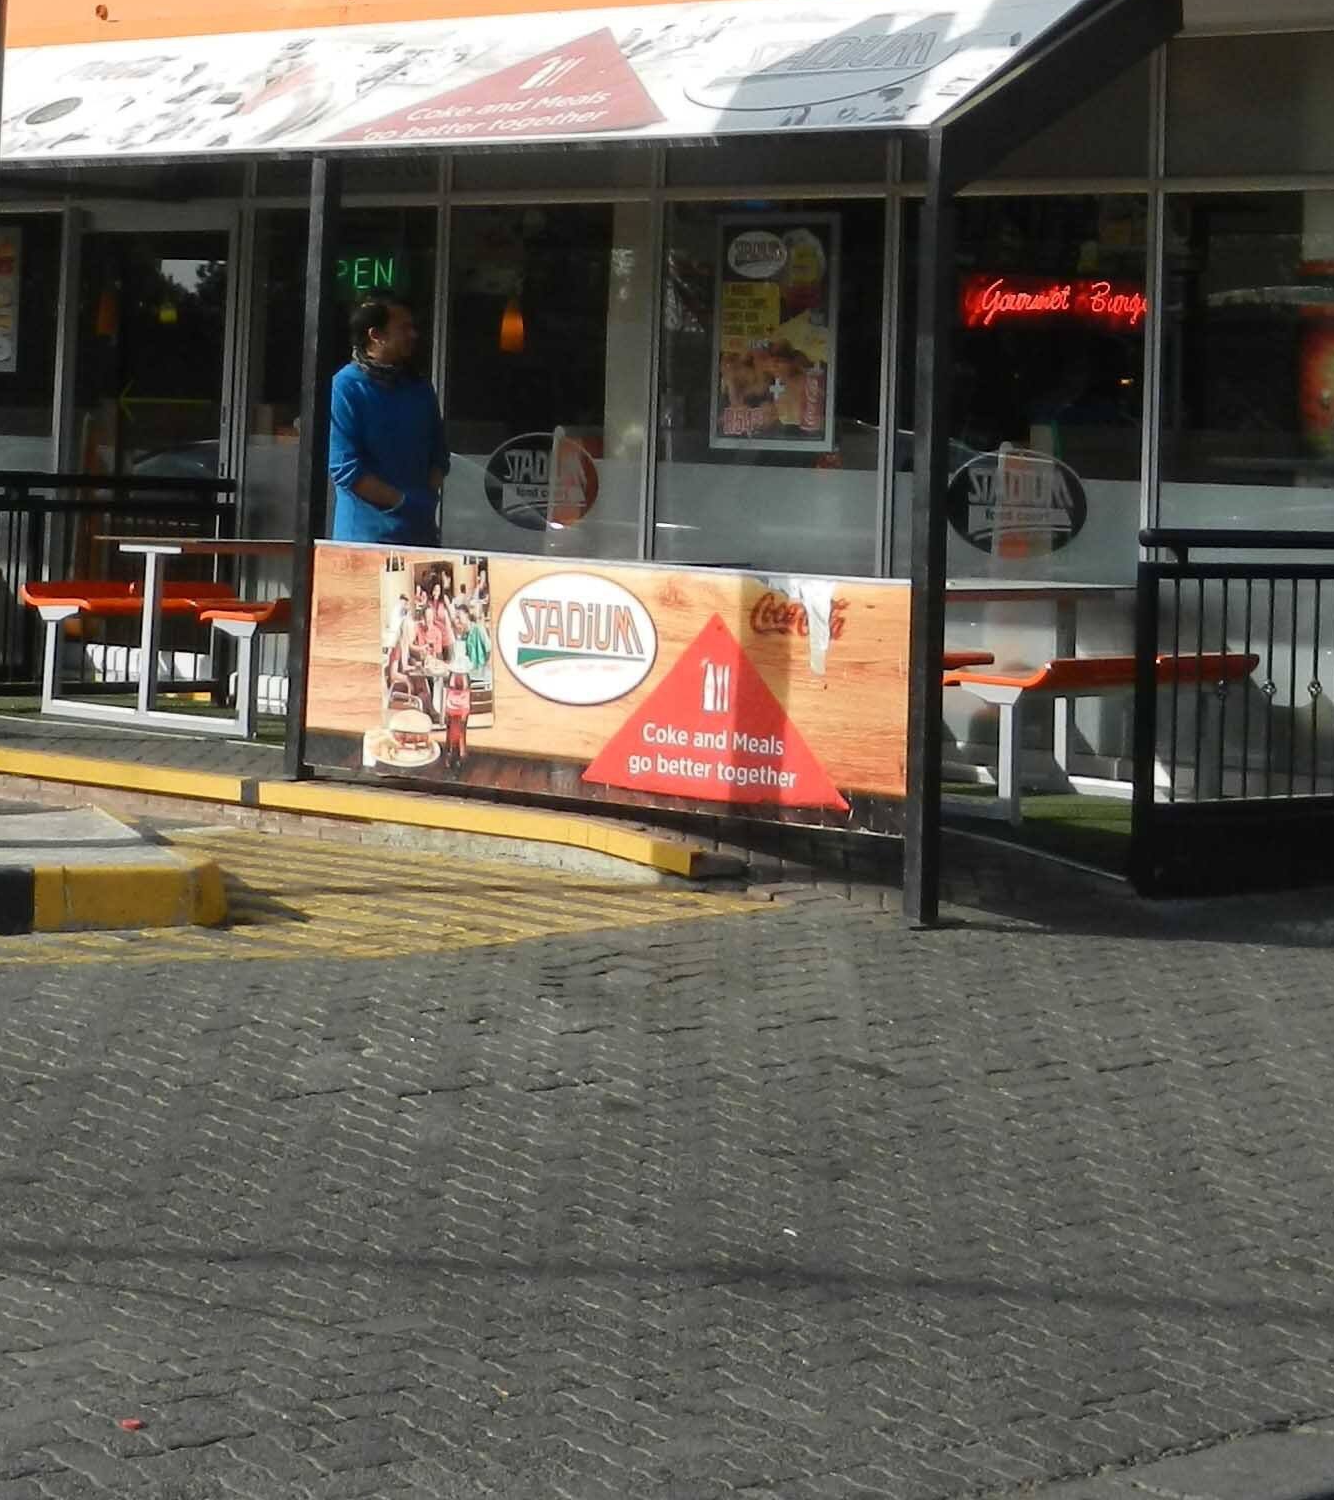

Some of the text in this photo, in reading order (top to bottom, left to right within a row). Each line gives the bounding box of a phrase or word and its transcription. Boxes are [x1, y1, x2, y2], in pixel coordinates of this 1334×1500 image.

[406, 89, 612, 123] Coke and Meals
[397, 120, 486, 140] better
[488, 108, 609, 134] together
[642, 722, 785, 756] Coke and Meals
[628, 752, 798, 788] go better together
